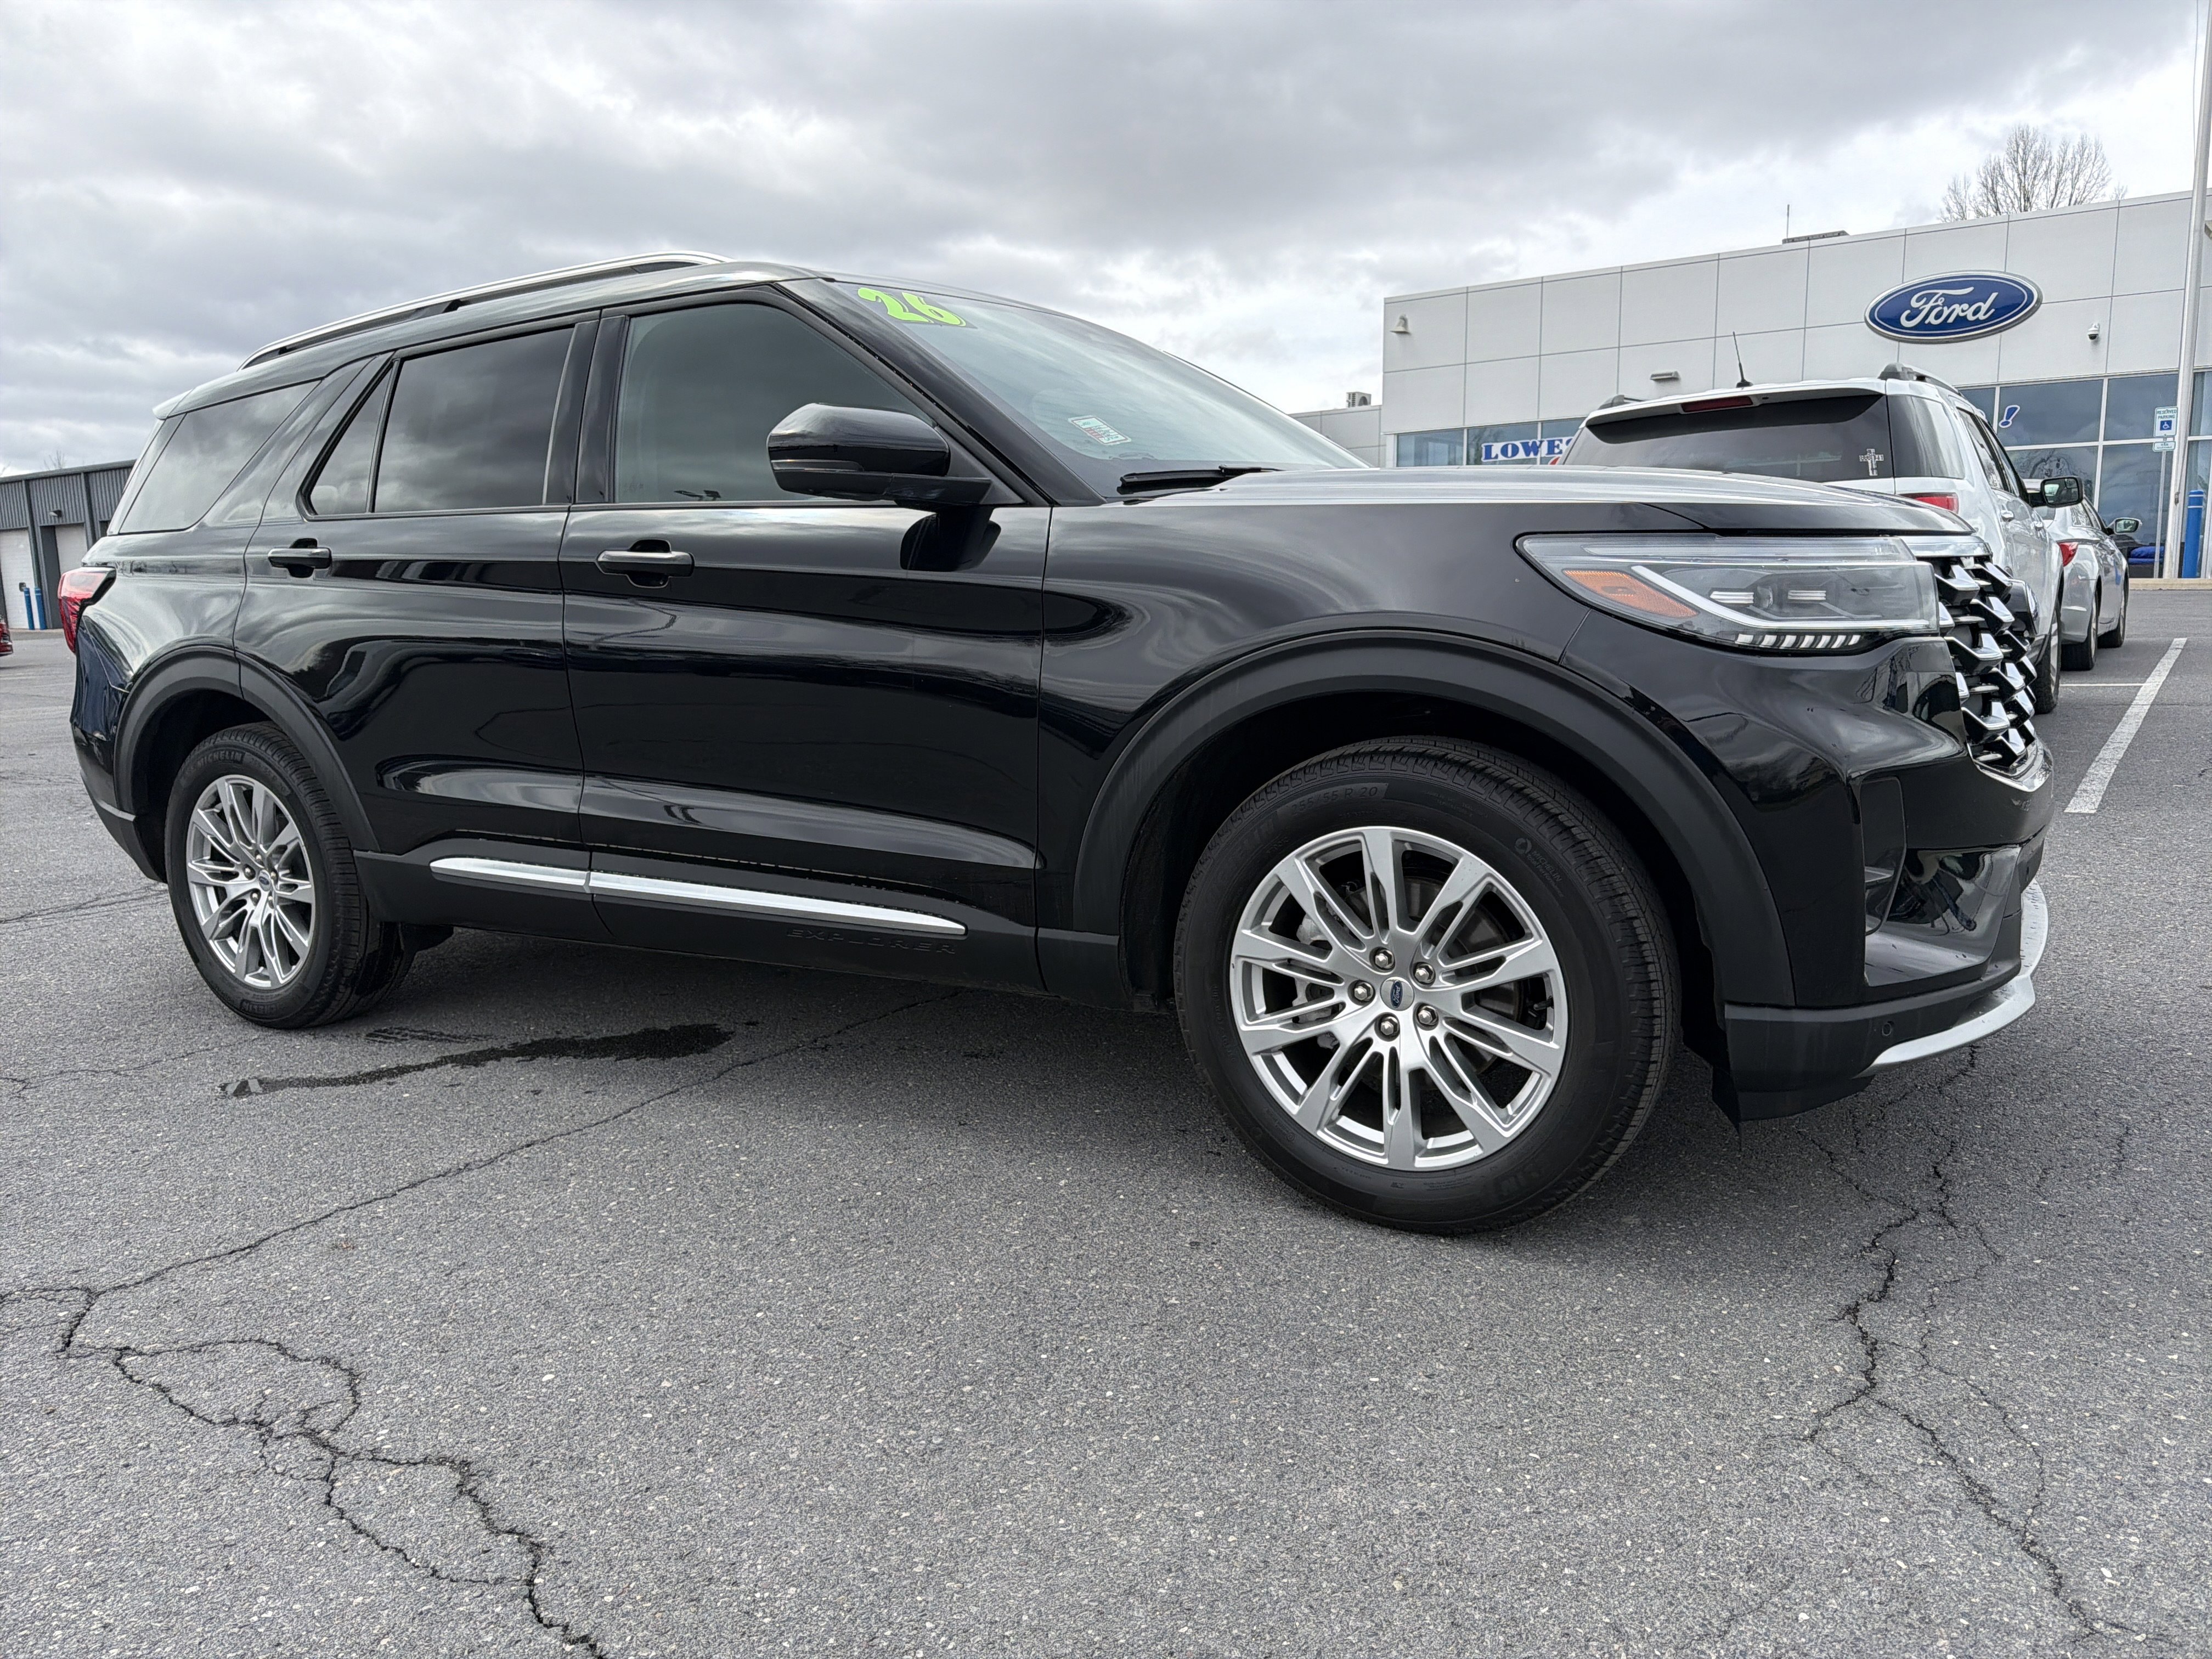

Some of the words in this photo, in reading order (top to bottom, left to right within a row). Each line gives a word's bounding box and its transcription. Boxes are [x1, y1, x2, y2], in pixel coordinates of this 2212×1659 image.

[857, 287, 966, 326] 26
[1900, 286, 1999, 328] Ford
[197, 751, 243, 768] MICHELIN
[1344, 788, 1353, 799] R
[1359, 787, 1378, 798] 20
[1392, 985, 1401, 1003] Ford
